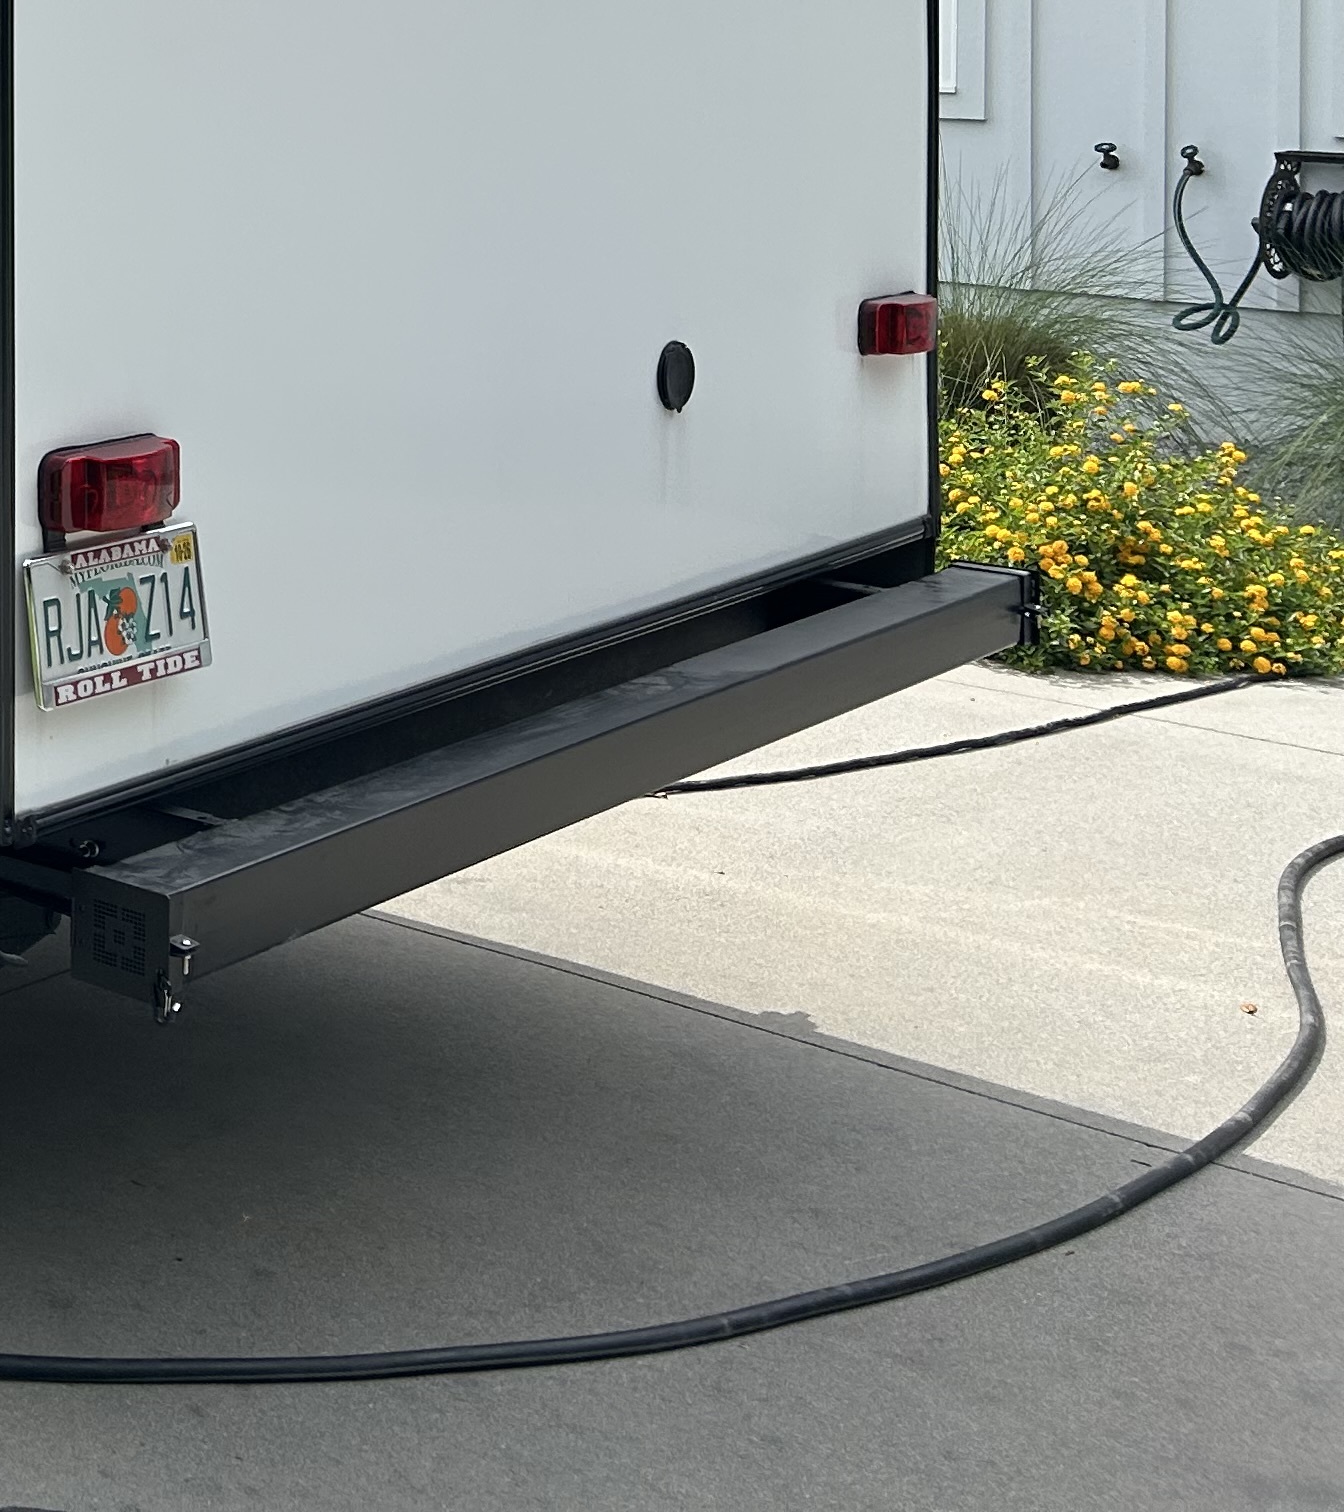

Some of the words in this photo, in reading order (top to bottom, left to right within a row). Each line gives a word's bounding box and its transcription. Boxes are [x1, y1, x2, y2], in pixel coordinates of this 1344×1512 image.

[75, 538, 160, 569] ALABAMA
[43, 589, 104, 668] RJA
[139, 566, 196, 642] Z14
[57, 671, 128, 704] ROLL
[137, 650, 201, 681] TIDE
